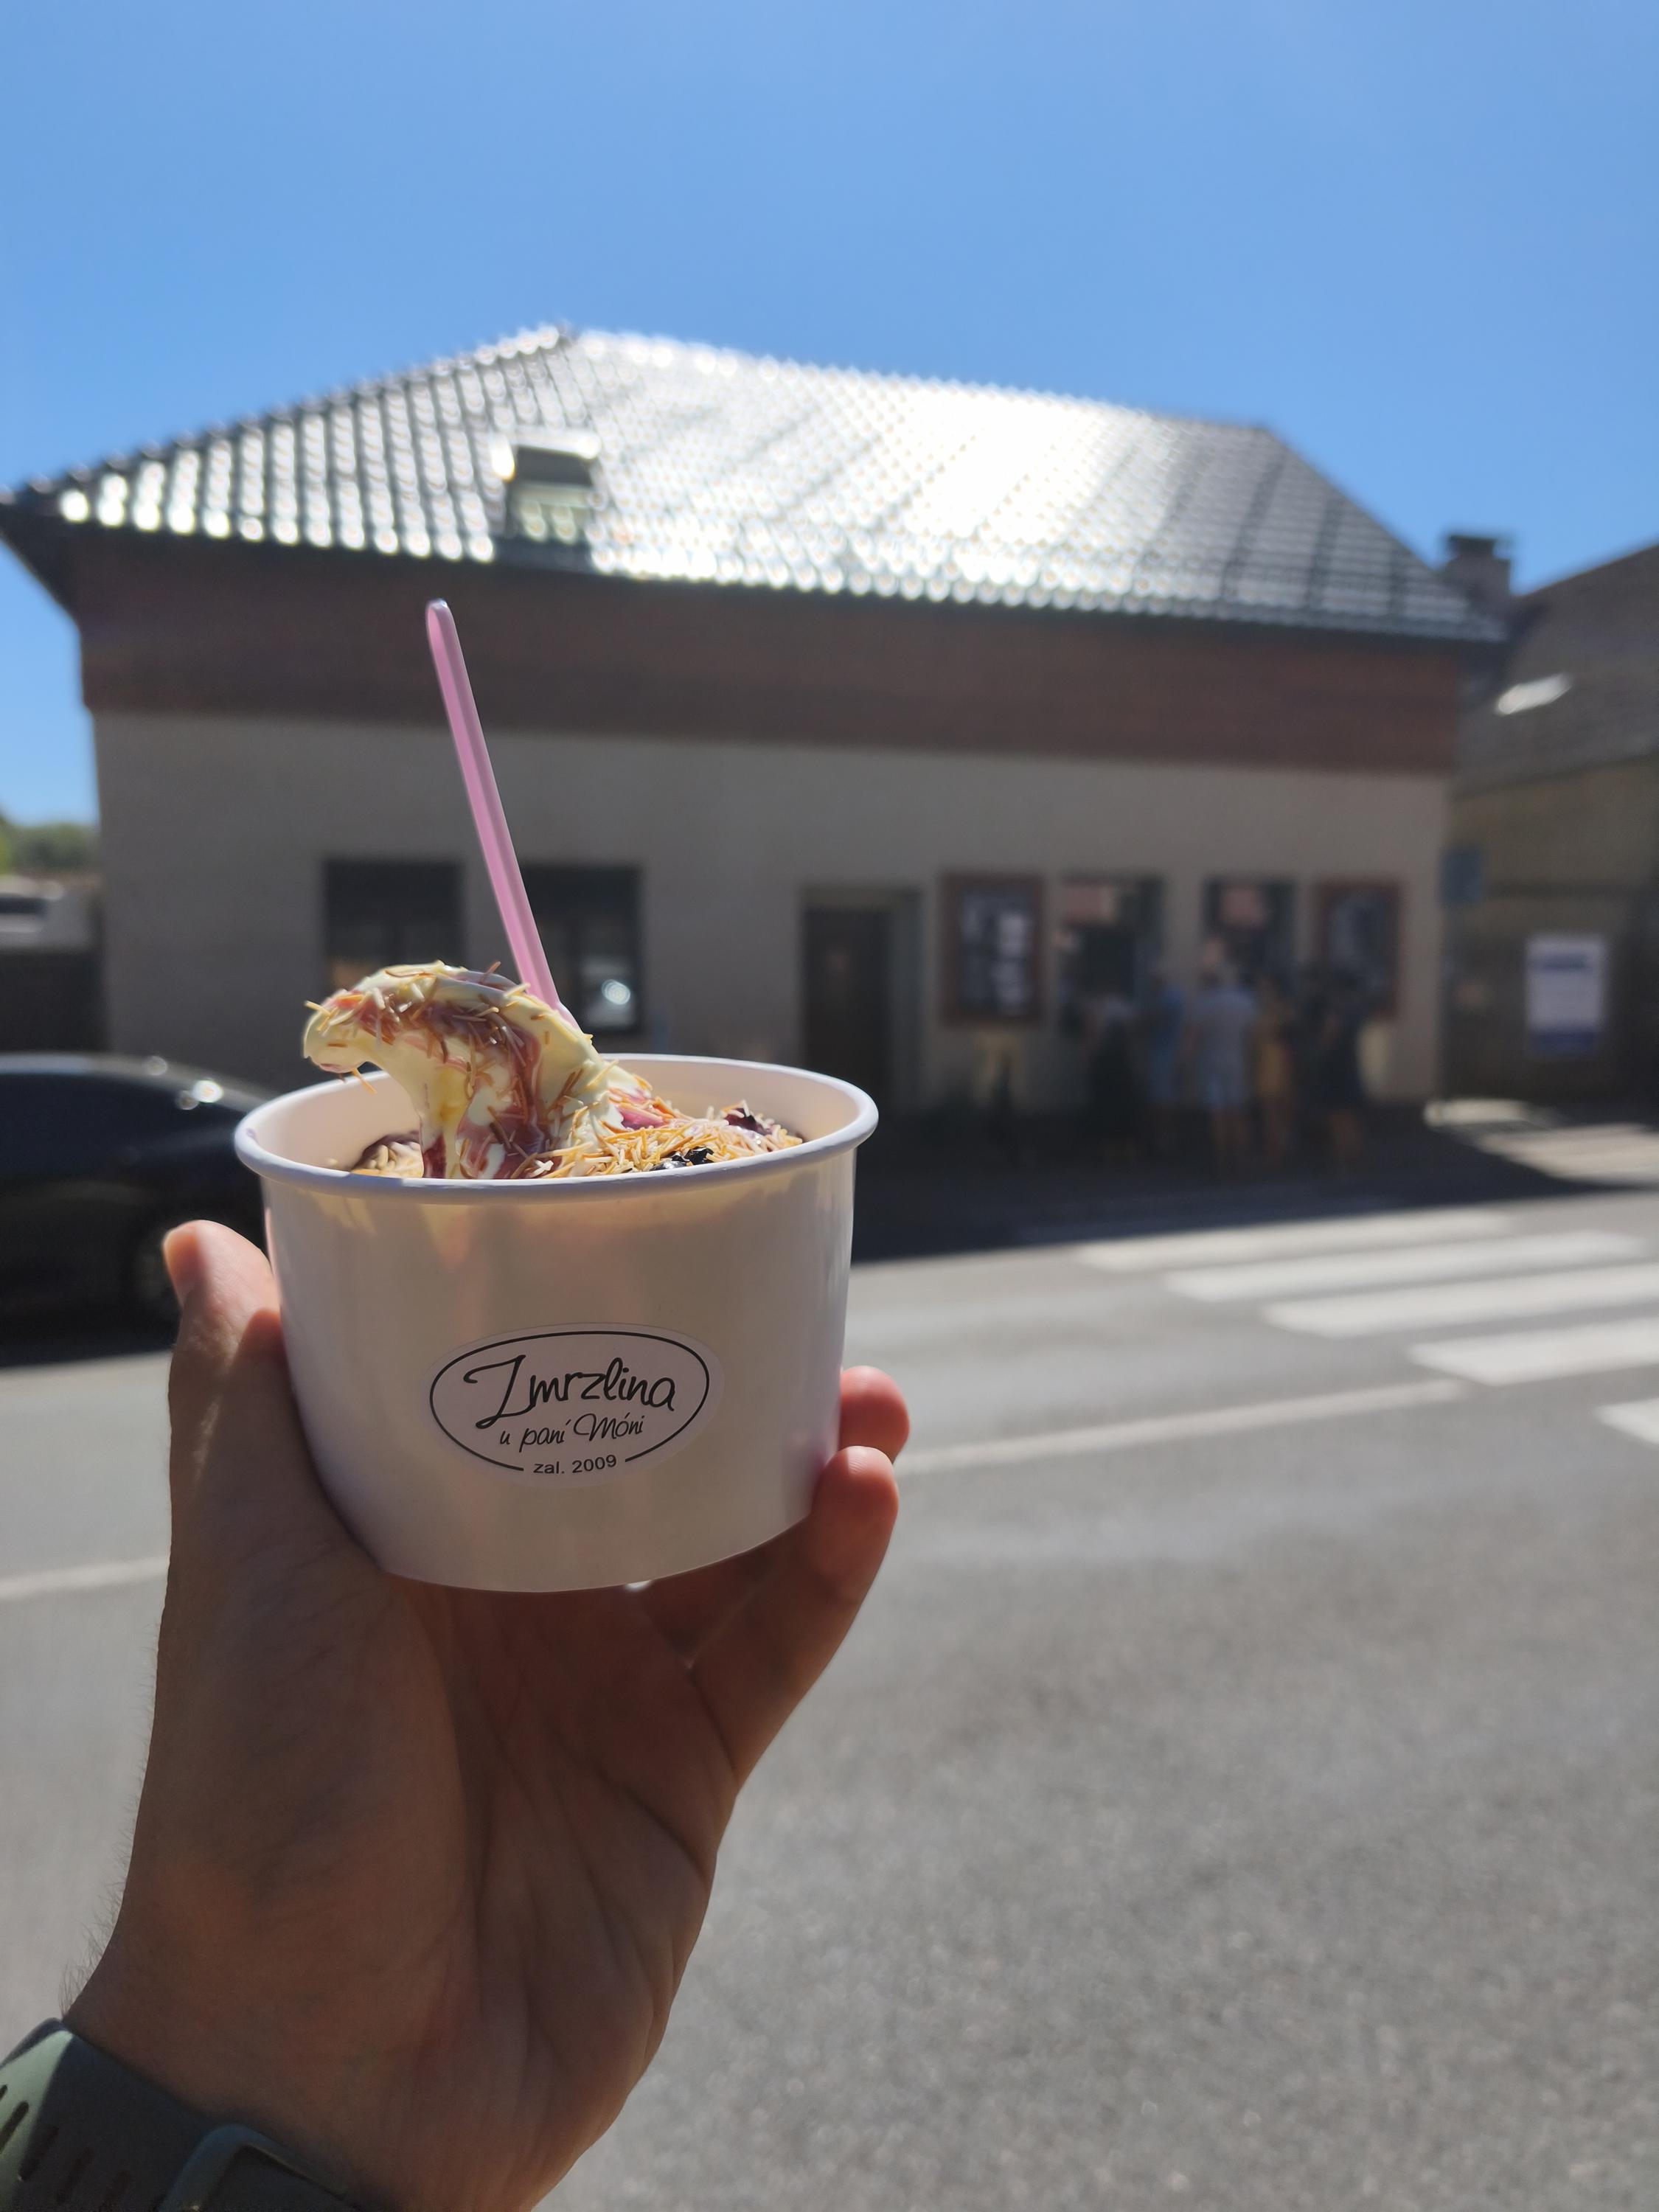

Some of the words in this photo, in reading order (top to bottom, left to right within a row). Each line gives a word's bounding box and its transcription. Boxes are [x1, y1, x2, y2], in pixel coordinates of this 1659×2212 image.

[463, 1354, 675, 1430] Zmrzlina
[499, 1429, 510, 1445] u
[518, 1419, 571, 1453] paní
[573, 1412, 645, 1441] Móni
[532, 1460, 565, 1474] zal.
[571, 1454, 617, 1473] 2009
